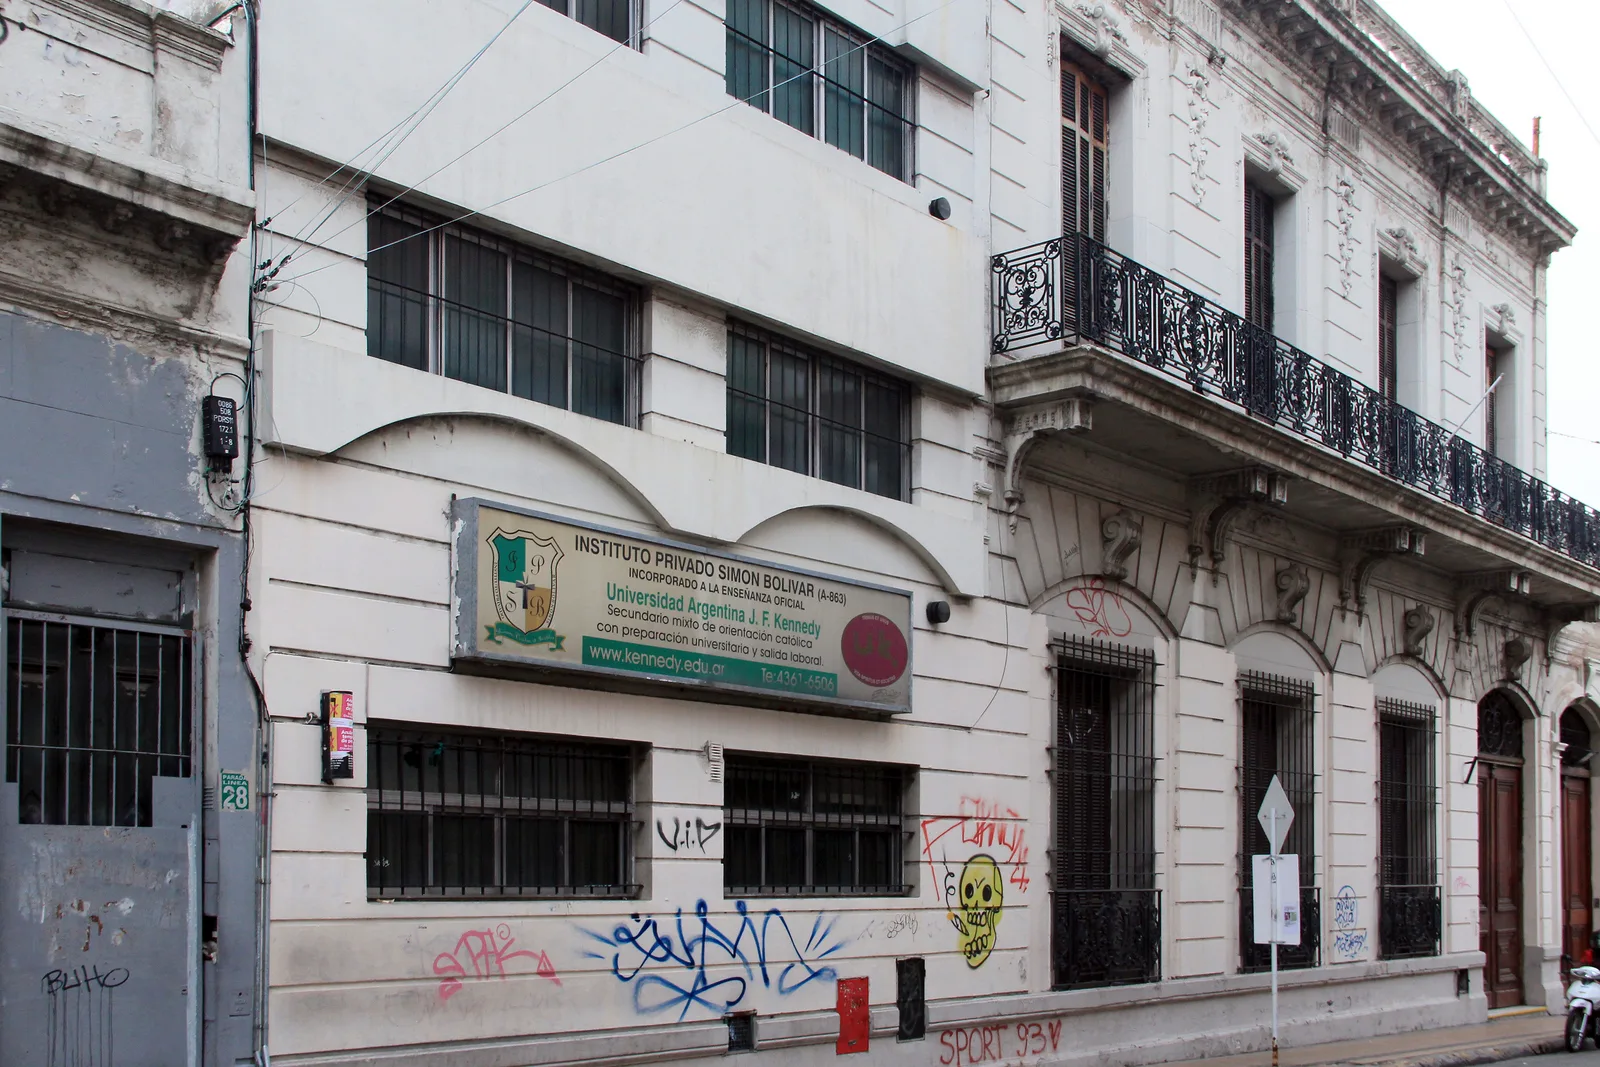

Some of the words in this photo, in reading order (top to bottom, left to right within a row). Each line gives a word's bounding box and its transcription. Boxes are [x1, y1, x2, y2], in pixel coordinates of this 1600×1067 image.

[218, 400, 233, 409] 0086
[220, 408, 232, 416] 508
[575, 534, 651, 565] INSTITUTO
[655, 551, 715, 578] PRIVADO
[718, 564, 760, 587] SIMON
[763, 574, 814, 598] BOLIVAR
[817, 588, 847, 607] (A-863)
[629, 567, 698, 590] INCORPORADO
[700, 581, 707, 592] A
[708, 582, 720, 594] LA
[722, 585, 772, 605] ENSEÑANZA
[774, 596, 806, 611] OFICIAL
[606, 581, 684, 612] Universidad
[687, 597, 745, 623] Argentina
[748, 610, 758, 625] J.
[762, 611, 770, 628] F.
[774, 613, 821, 640] Kennedy
[607, 603, 670, 625] Secundario
[672, 616, 700, 630] mixto
[702, 621, 716, 633] de
[718, 625, 773, 642] orientación
[775, 632, 813, 649] católica
[589, 644, 725, 676] www.kennedy.edu.ar
[596, 622, 619, 634] con
[622, 626, 688, 645] preparación
[691, 637, 750, 655] universitaria
[752, 647, 758, 658] y
[760, 648, 788, 661] salida
[790, 651, 825, 667] laboral.
[222, 785, 248, 809] 28
[940, 1023, 1008, 1067] SPORT
